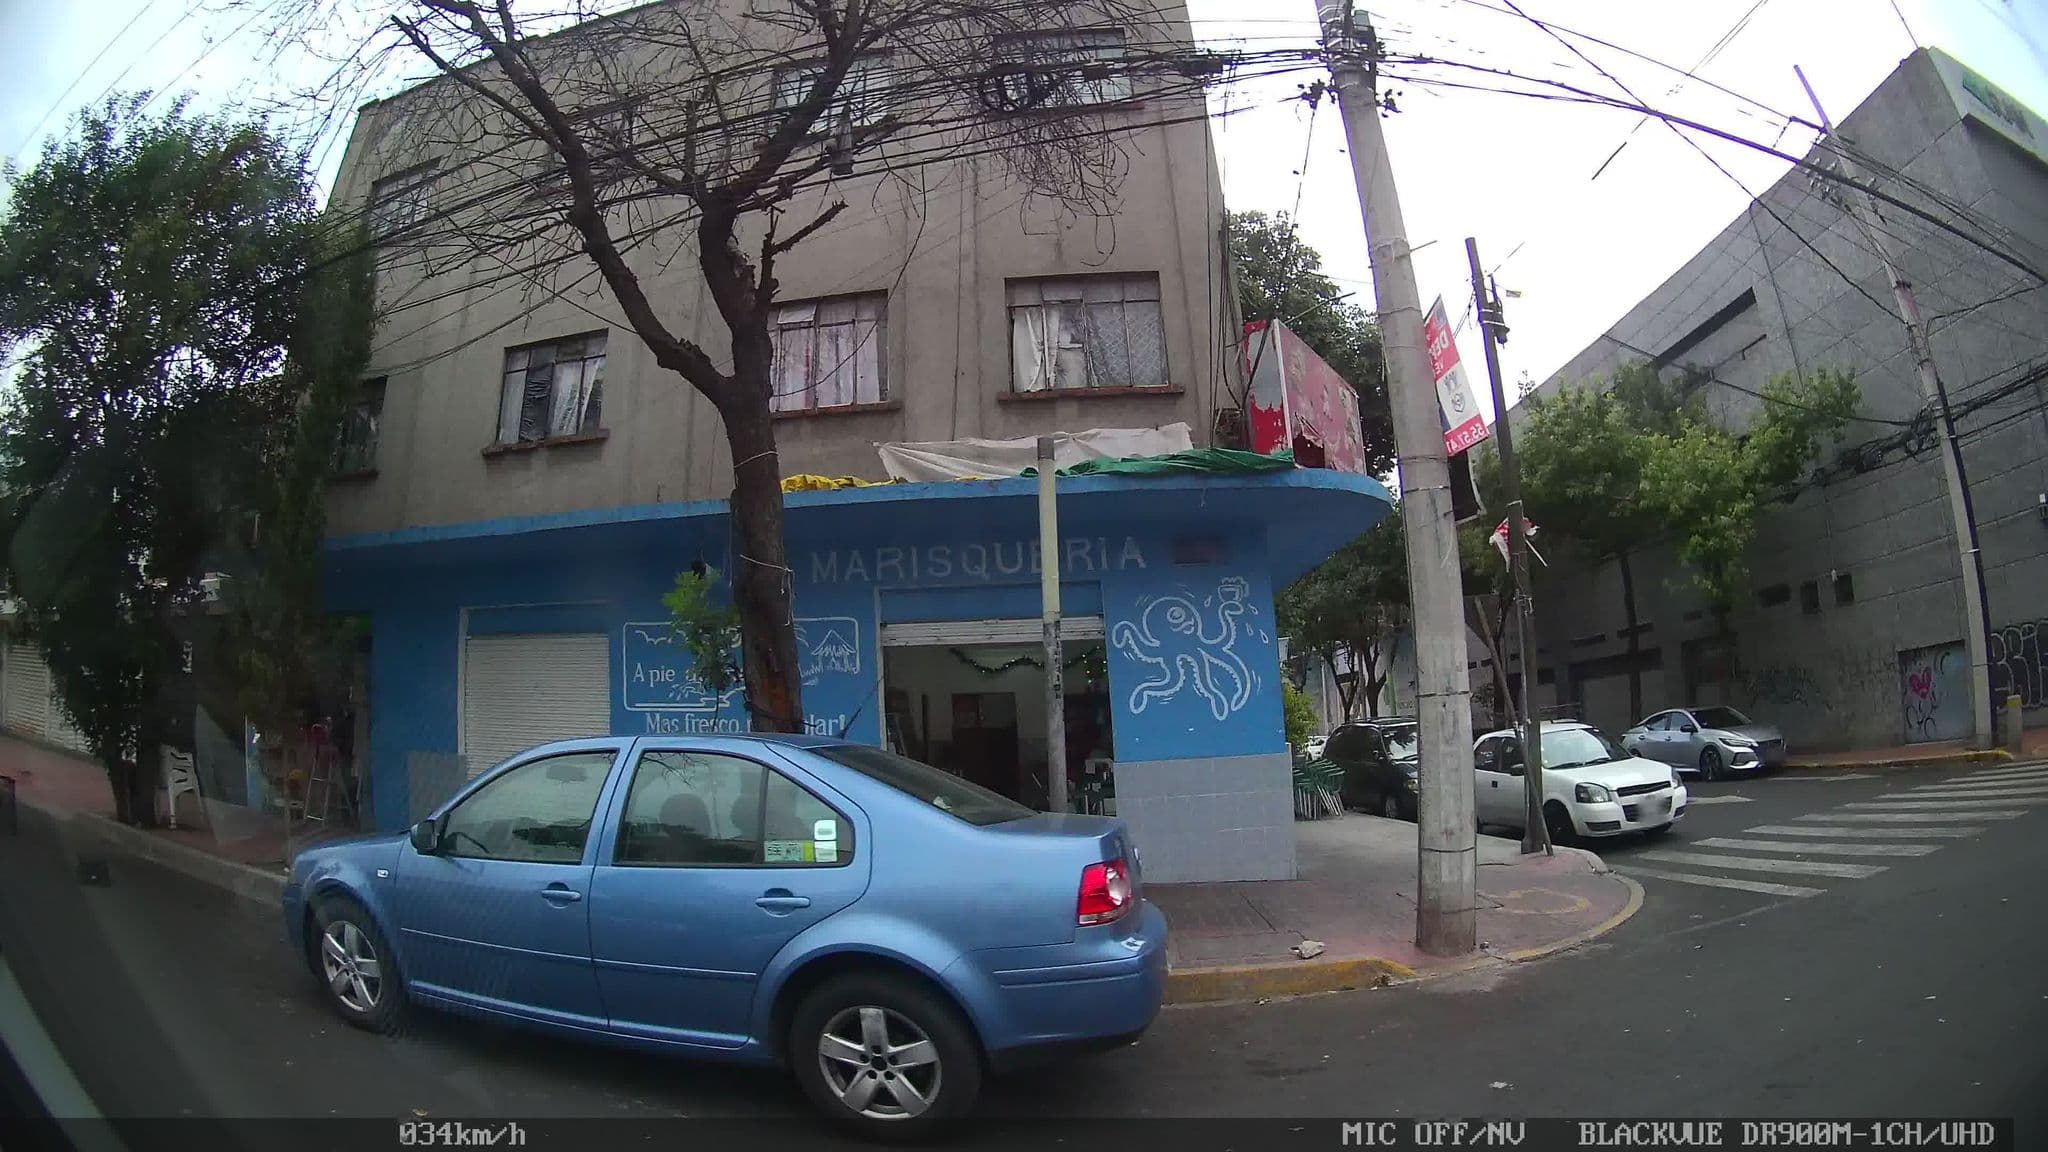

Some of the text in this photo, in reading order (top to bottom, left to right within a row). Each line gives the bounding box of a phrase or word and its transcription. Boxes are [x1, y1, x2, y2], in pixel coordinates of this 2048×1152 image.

[633, 663, 645, 683] A
[648, 664, 676, 688] pie
[645, 712, 681, 733] Mas
